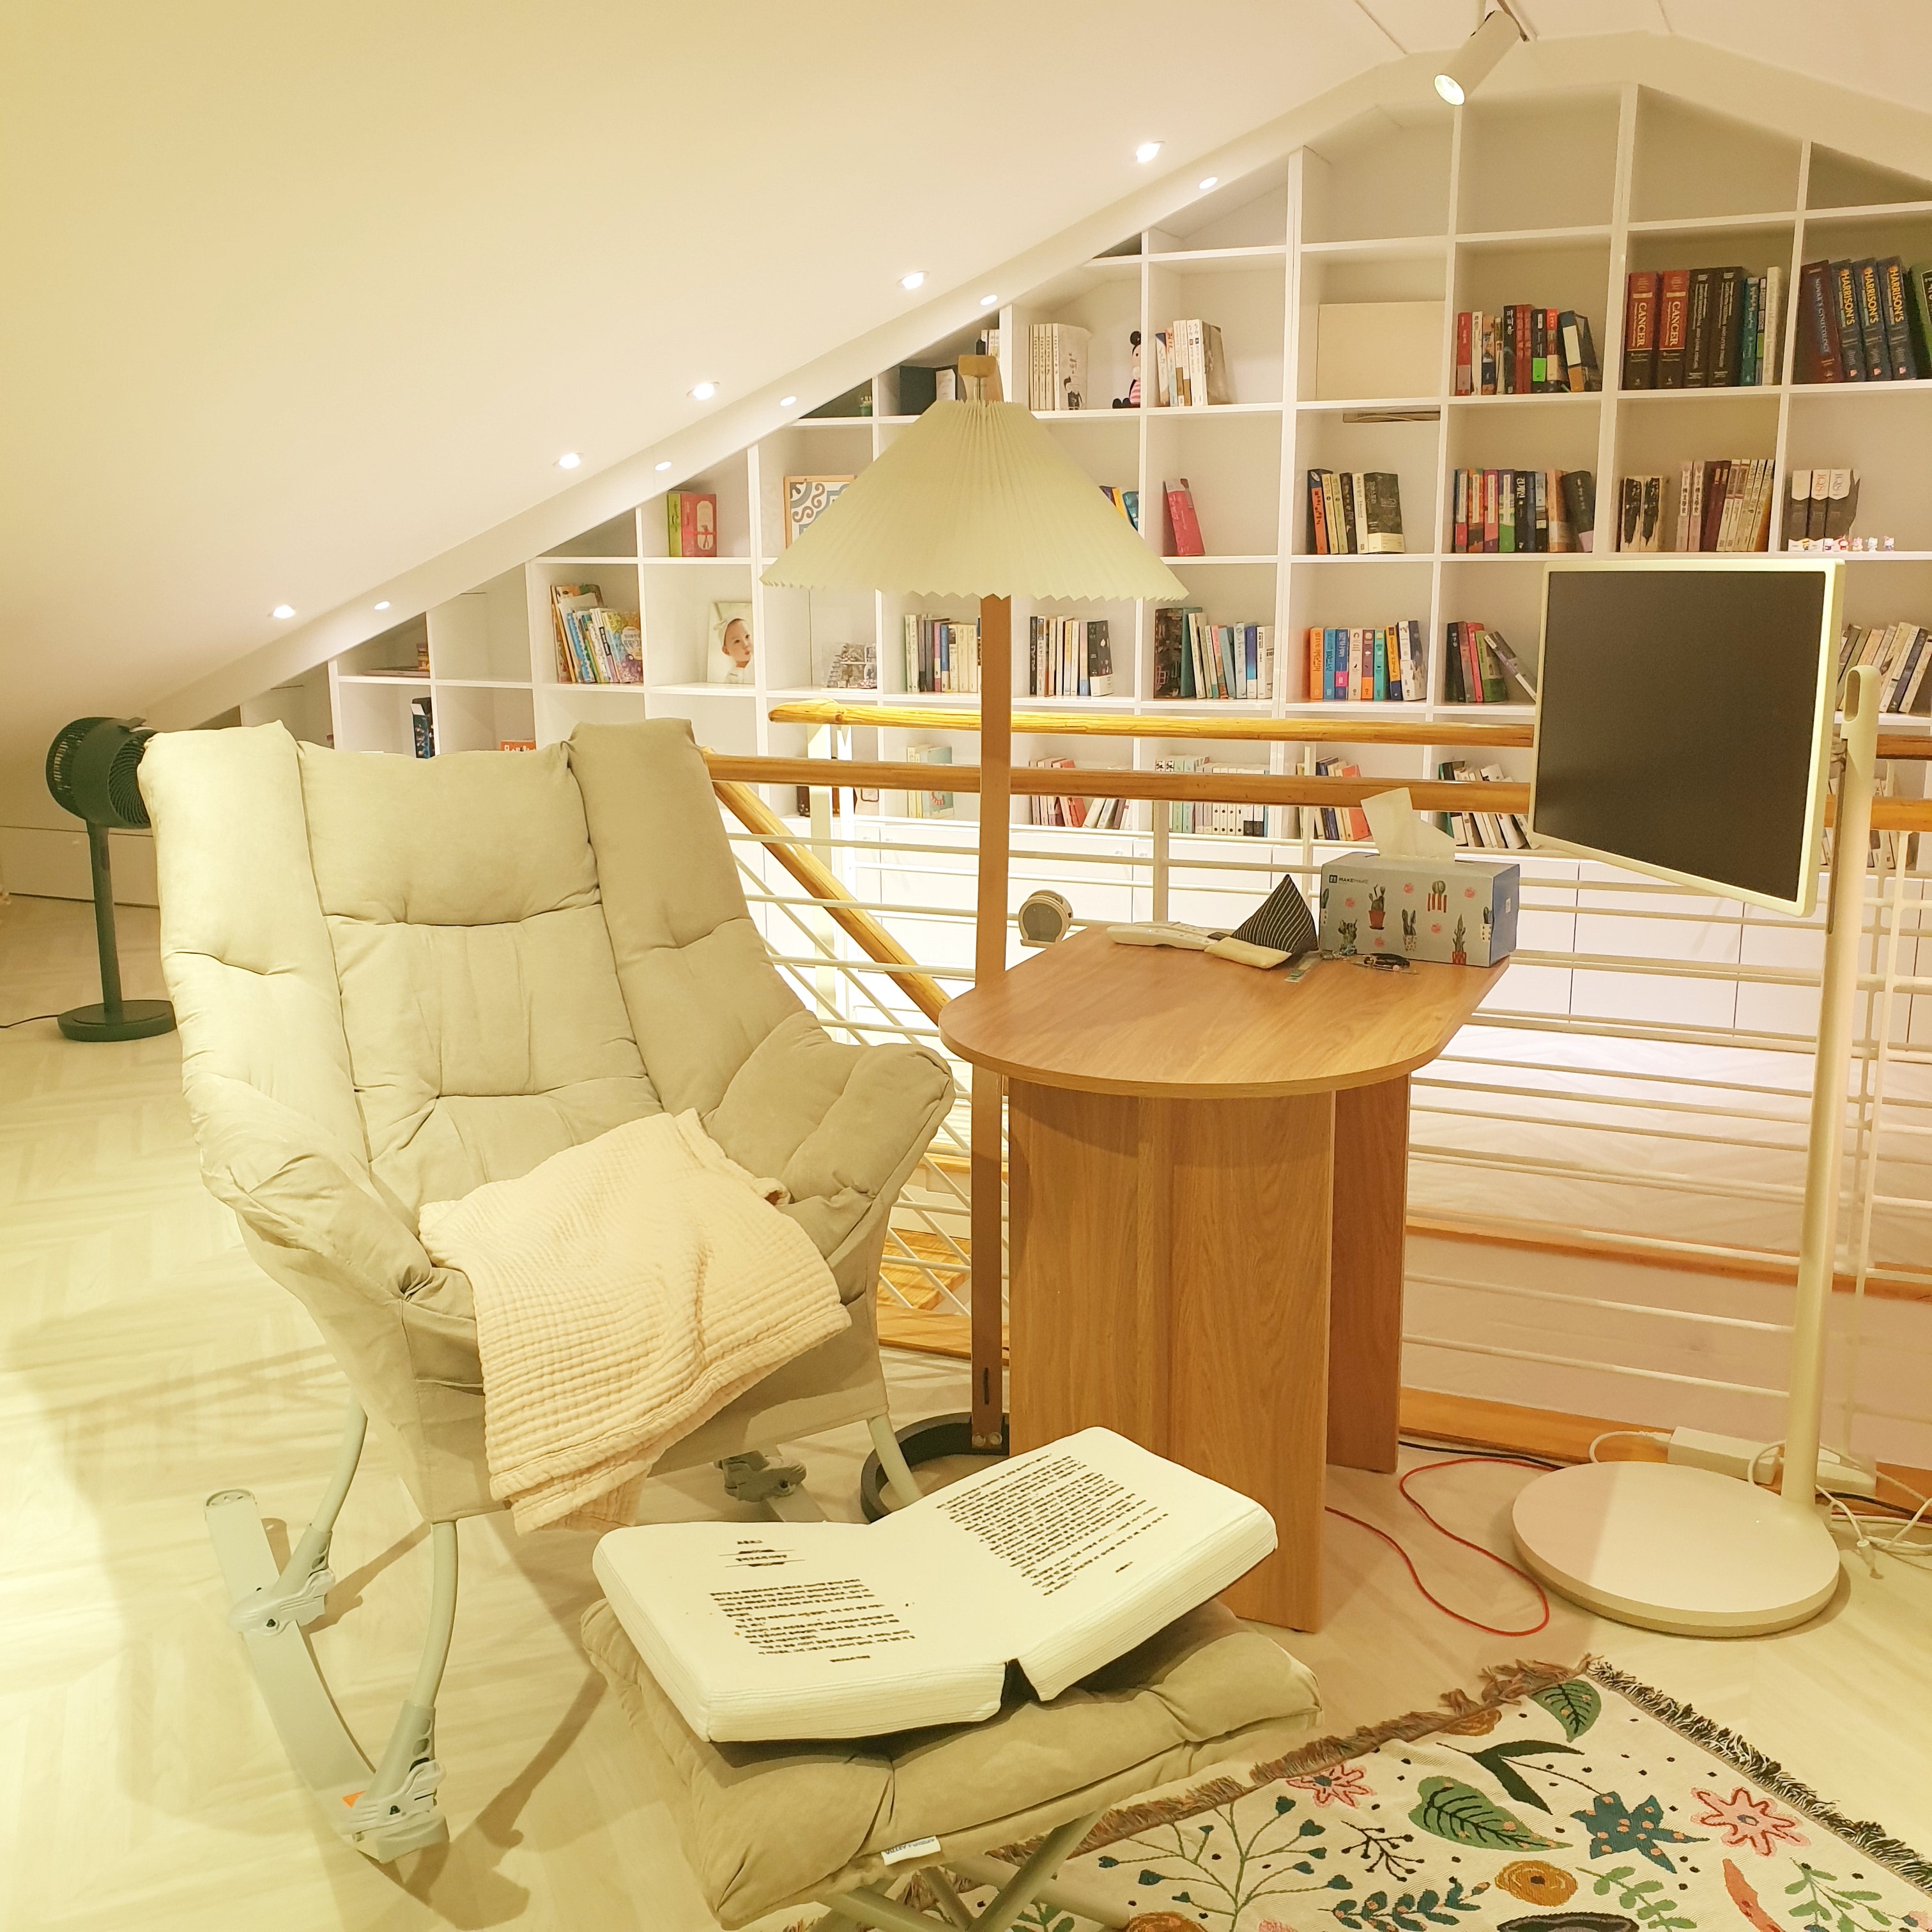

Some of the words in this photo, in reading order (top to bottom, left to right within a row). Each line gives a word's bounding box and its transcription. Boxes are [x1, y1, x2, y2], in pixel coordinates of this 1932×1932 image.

[1841, 273, 1855, 325] HARRISON'S
[1864, 271, 1879, 324] HARRISON'S
[1890, 268, 1905, 323] HARRISON'S
[1637, 302, 1648, 347] CANCER
[1670, 301, 1681, 346] CANCER
